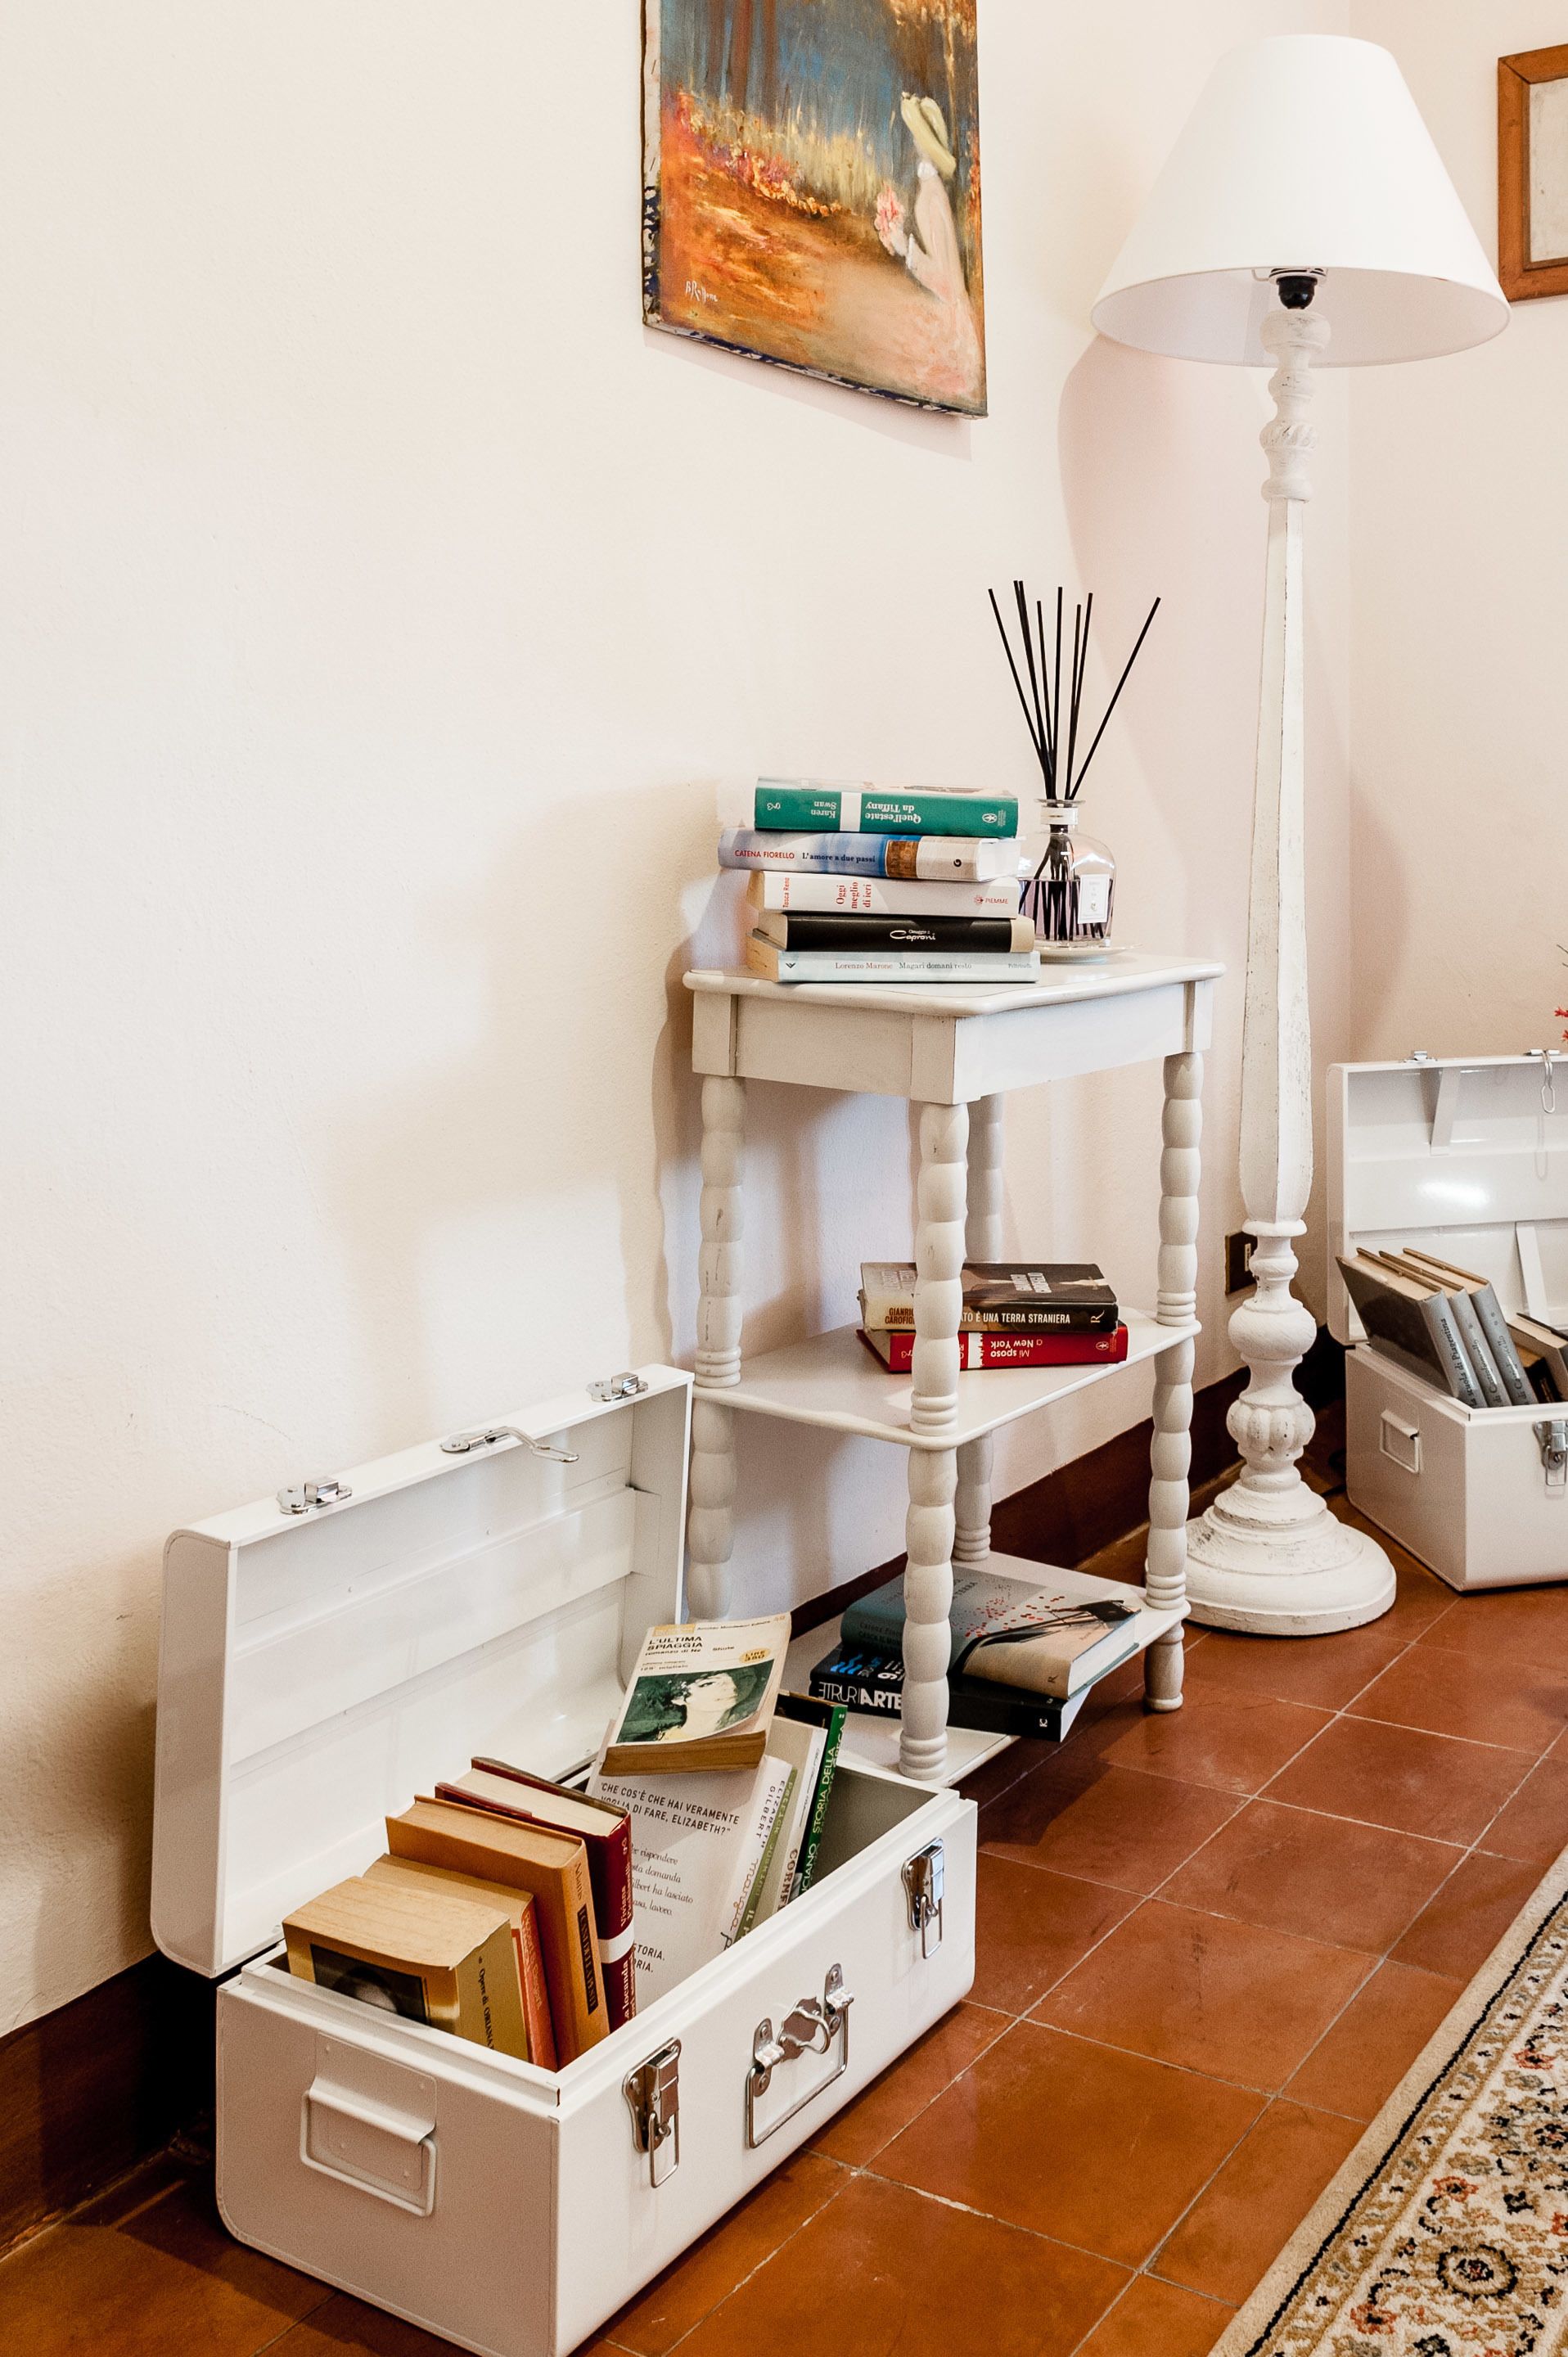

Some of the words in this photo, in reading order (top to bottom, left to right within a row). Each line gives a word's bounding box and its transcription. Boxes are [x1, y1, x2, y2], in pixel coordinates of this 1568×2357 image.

[813, 800, 837, 809] Swan
[865, 801, 900, 813] Tiffany
[903, 804, 915, 813] da
[810, 809, 836, 819] Karen
[865, 812, 921, 824] Quell'estate
[735, 850, 761, 858] CATENA
[763, 851, 795, 859] FIORELLO
[802, 852, 833, 860] L'amore
[840, 854, 854, 862] due
[856, 855, 876, 863] passi
[836, 885, 846, 905] Oggi
[850, 881, 859, 909] meglio
[863, 884, 872, 899] ieri
[863, 899, 871, 908] di
[890, 930, 936, 942] Caproni
[835, 962, 864, 970] Lorenzo
[866, 962, 893, 970] Marone
[899, 962, 926, 971] Magari
[926, 962, 953, 970] domani
[983, 1312, 999, 1323] UNA
[1001, 1312, 1025, 1323] TERRA
[1028, 1313, 1070, 1324] STRANIERA
[990, 1339, 1011, 1348] York
[1013, 1339, 1034, 1348] New
[990, 1350, 1017, 1359] sposo
[1019, 1349, 1030, 1358] Mi
[647, 1642, 703, 1651] SPIAGGIA
[649, 1636, 702, 1645] L'ULTIMA
[813, 1790, 828, 1834] STORIA
[822, 1746, 836, 1784] DELLA
[620, 1787, 646, 1801] COS'È
[647, 1794, 665, 1806] CHE
[667, 1798, 683, 1811] HAI
[686, 1803, 739, 1825] VERAMENTE
[756, 1786, 776, 1838] GILBERT
[633, 1804, 642, 1814] DI
[644, 1807, 669, 1823] FARE,
[671, 1814, 731, 1836] ELIZABETH?"
[760, 1780, 786, 1849] ELIZABETH
[640, 1848, 678, 1865] rispondere
[645, 1866, 681, 1883] domanda
[632, 1877, 651, 1892] ilbert
[652, 1883, 663, 1895] ha
[665, 1886, 693, 1904] lasciato
[633, 1900, 647, 1909] asa,
[621, 1959, 629, 2010] locanda
